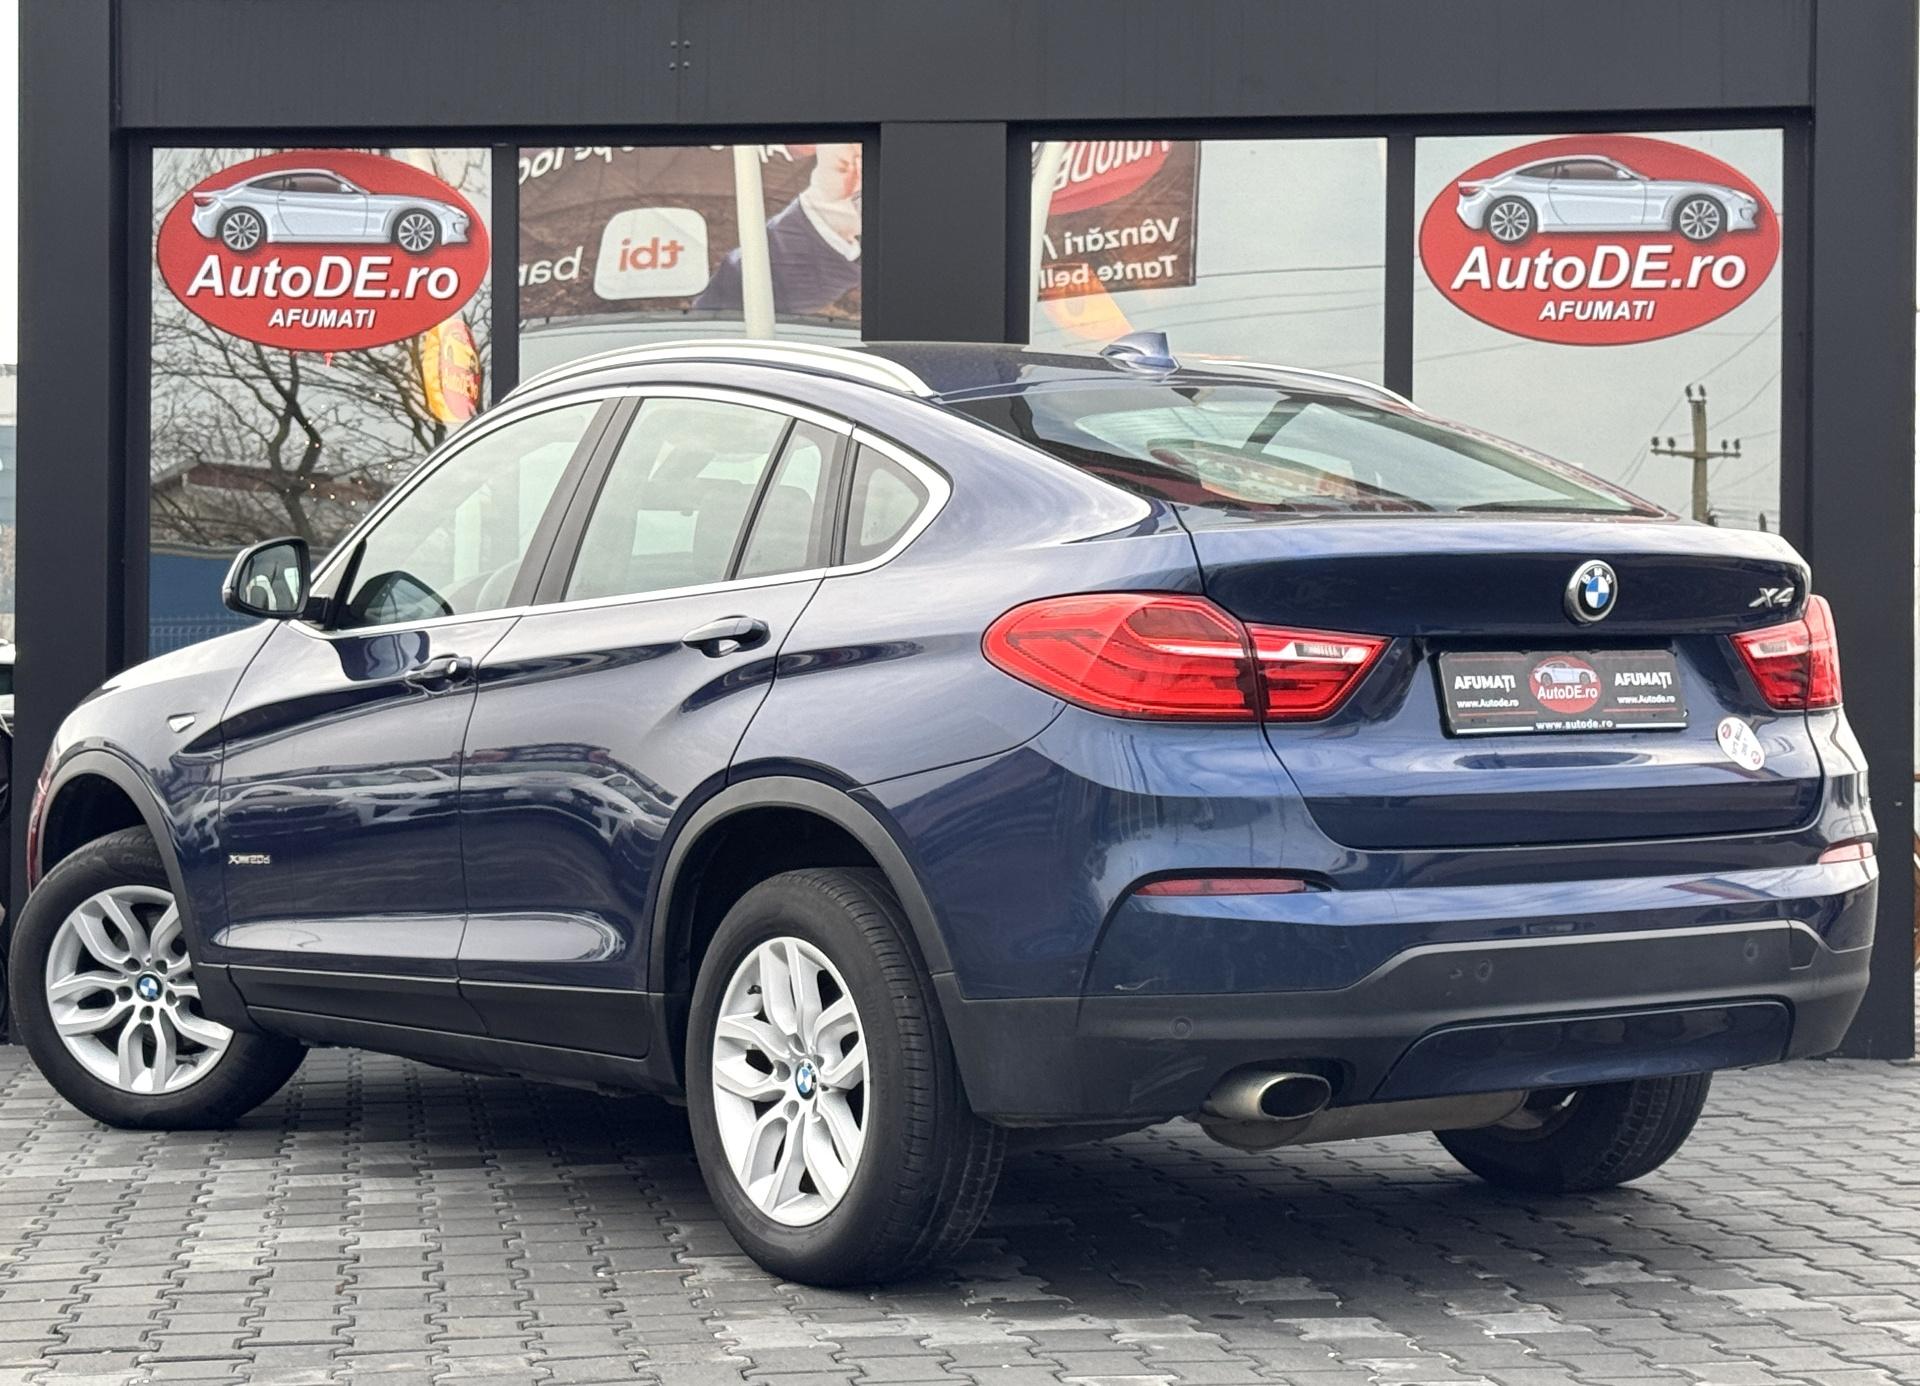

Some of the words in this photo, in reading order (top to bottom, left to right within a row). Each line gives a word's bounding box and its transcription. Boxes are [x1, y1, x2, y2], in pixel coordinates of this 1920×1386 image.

[186, 254, 461, 299] AutoDE.ro
[1451, 244, 1748, 291] AutoDE.ro
[267, 308, 377, 329] AFUMATI
[1538, 300, 1657, 321] AFUMATI
[1748, 587, 1795, 608] X4
[1537, 684, 1599, 700] AutoDE.ro
[1535, 719, 1614, 731] www.autode.ro
